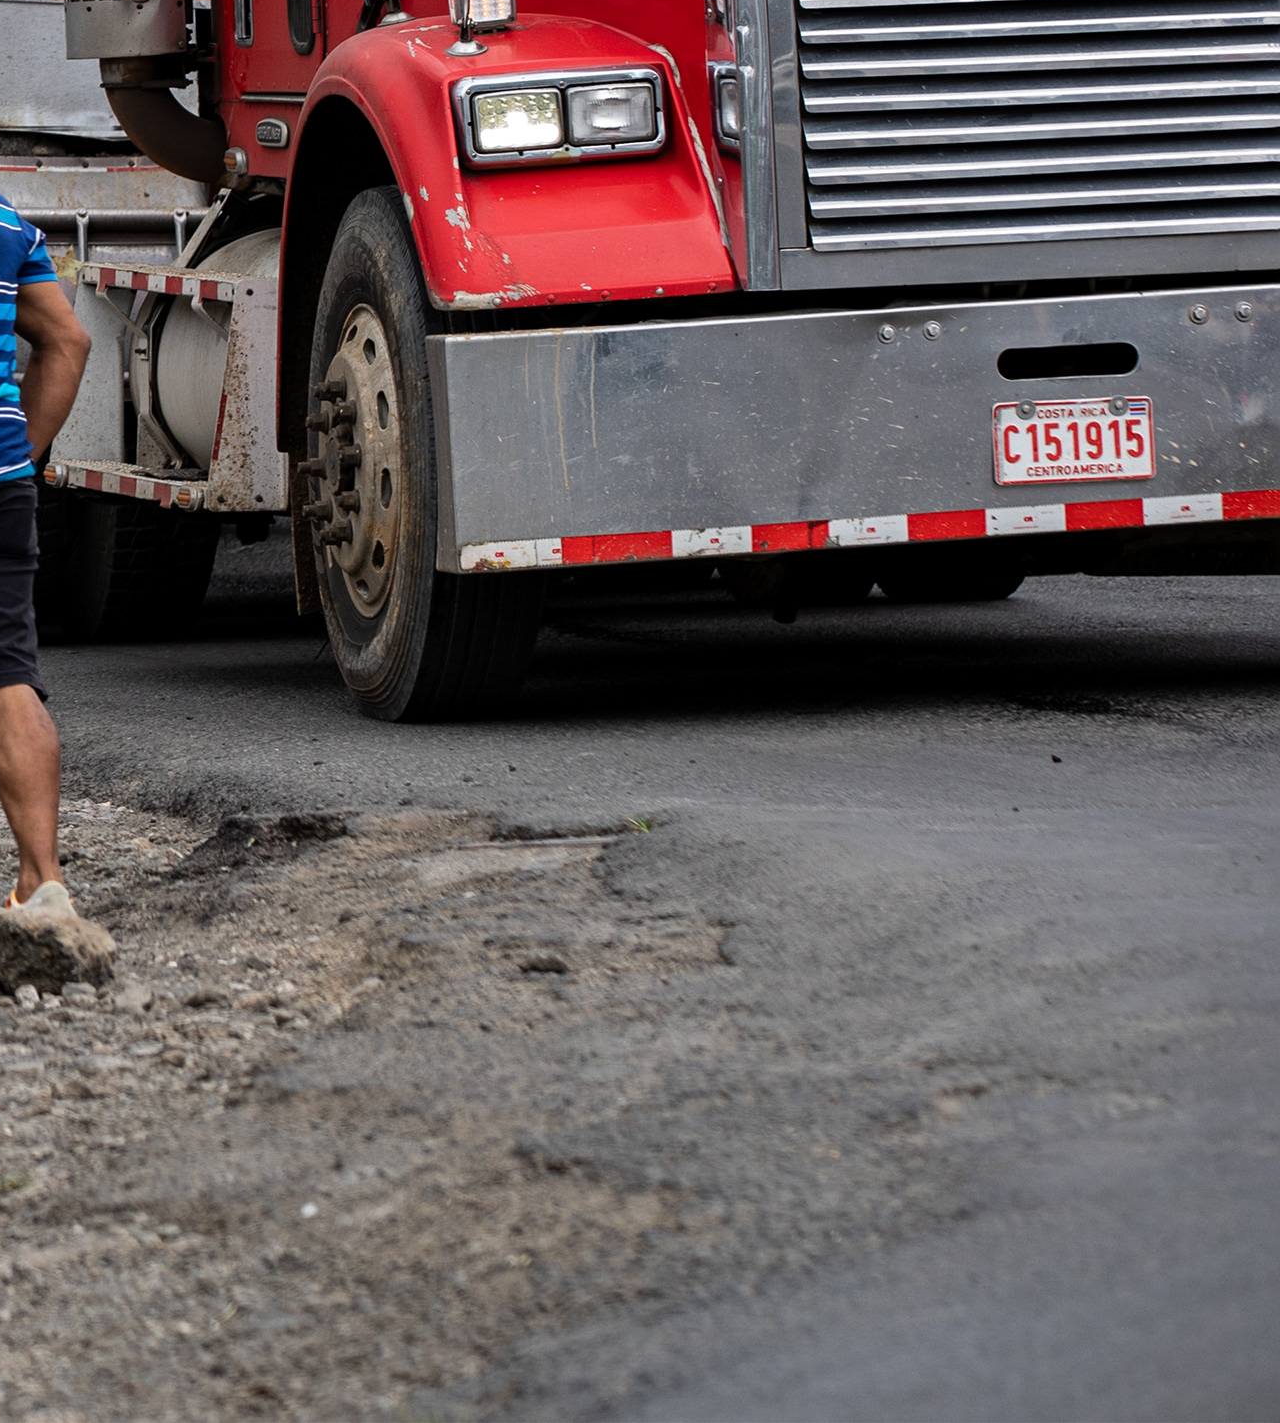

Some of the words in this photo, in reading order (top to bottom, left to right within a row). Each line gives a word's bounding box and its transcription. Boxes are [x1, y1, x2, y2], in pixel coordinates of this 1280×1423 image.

[1037, 407, 1075, 419] COSTA
[1080, 406, 1107, 418] RICA
[1003, 419, 1144, 464] C151915
[1026, 463, 1124, 477] CENTROAMERICA
